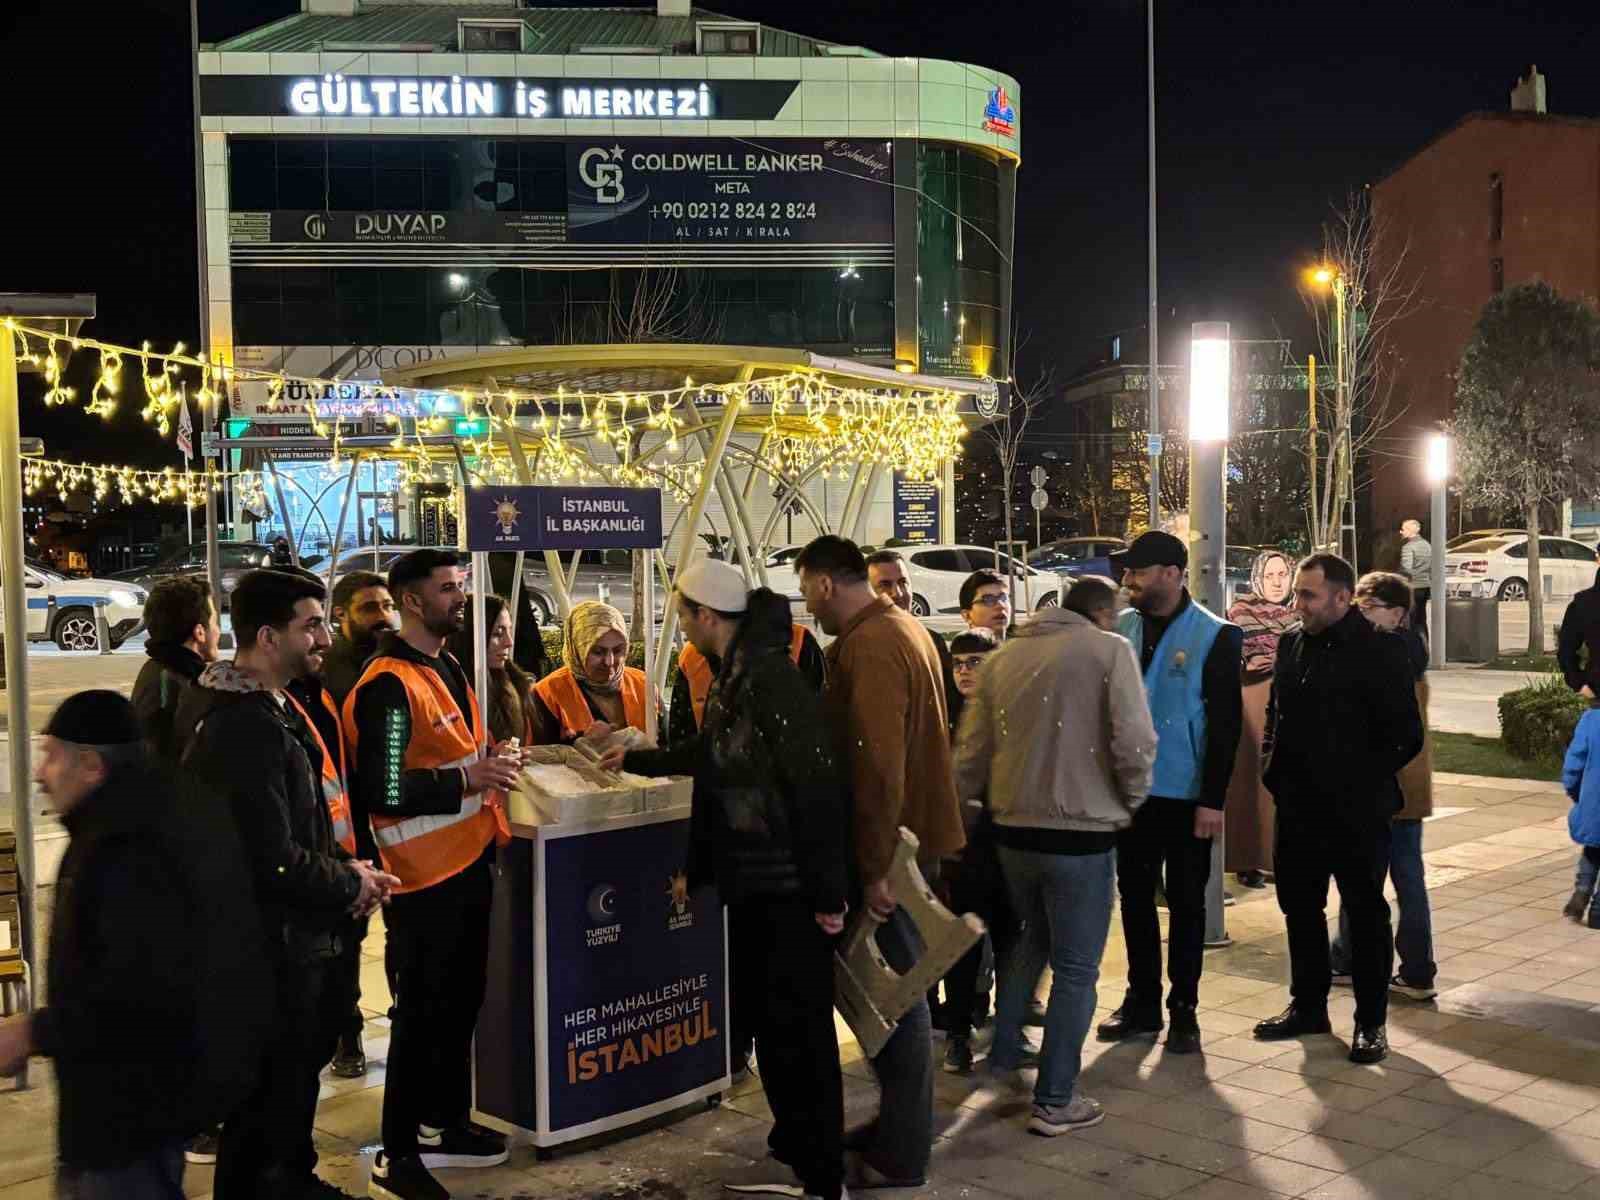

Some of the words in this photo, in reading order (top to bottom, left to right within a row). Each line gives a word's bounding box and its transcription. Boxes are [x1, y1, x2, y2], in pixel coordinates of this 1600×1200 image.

[290, 73, 495, 115] GÜLTEKİN
[562, 81, 710, 117] MERKEZİ
[631, 153, 740, 171] COLDWELL
[745, 153, 823, 172] BANKER
[714, 181, 751, 194] META
[648, 202, 683, 219] +90
[688, 202, 730, 219] 0212
[735, 202, 765, 219] 824
[770, 202, 781, 219] 2
[786, 202, 817, 219] 824
[355, 214, 446, 234] DUYAP
[675, 227, 691, 237] AL
[562, 497, 630, 513] İSTANBUL
[547, 515, 559, 531] İL
[563, 516, 645, 534] BAŞKANLIĞI
[564, 1007, 597, 1029] HER
[601, 973, 708, 1018] MAHALLESİYLE
[575, 1026, 607, 1048] HER
[611, 996, 701, 1038] HİKAYESİYLE
[567, 1000, 718, 1085] İSTANBUL
